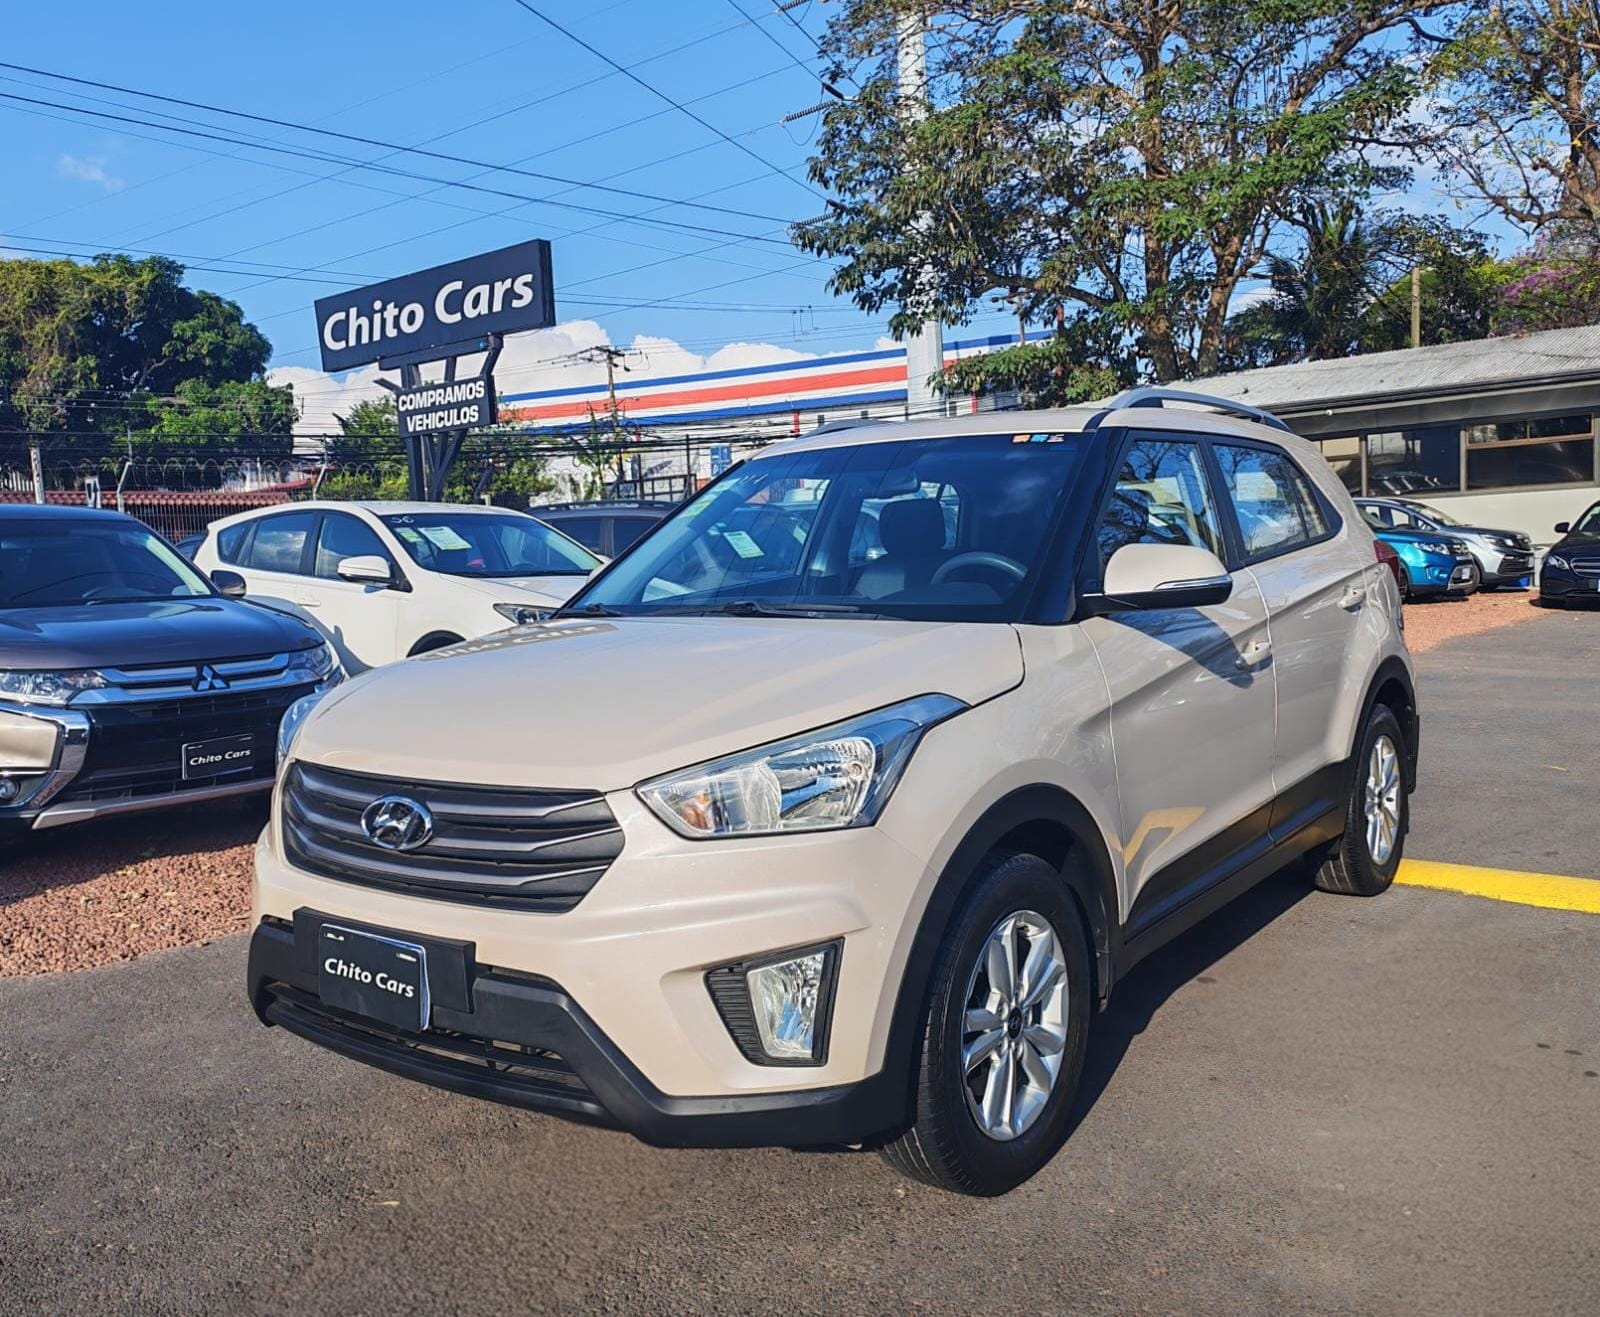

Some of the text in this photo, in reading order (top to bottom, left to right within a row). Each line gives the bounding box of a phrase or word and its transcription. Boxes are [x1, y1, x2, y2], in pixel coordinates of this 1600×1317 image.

[323, 273, 534, 352] Chito Cars
[398, 380, 485, 412] COMPRAMOS
[406, 405, 479, 433] VEHICULOS
[189, 749, 252, 766] Chito Cars
[324, 957, 415, 998] Chito Cars
